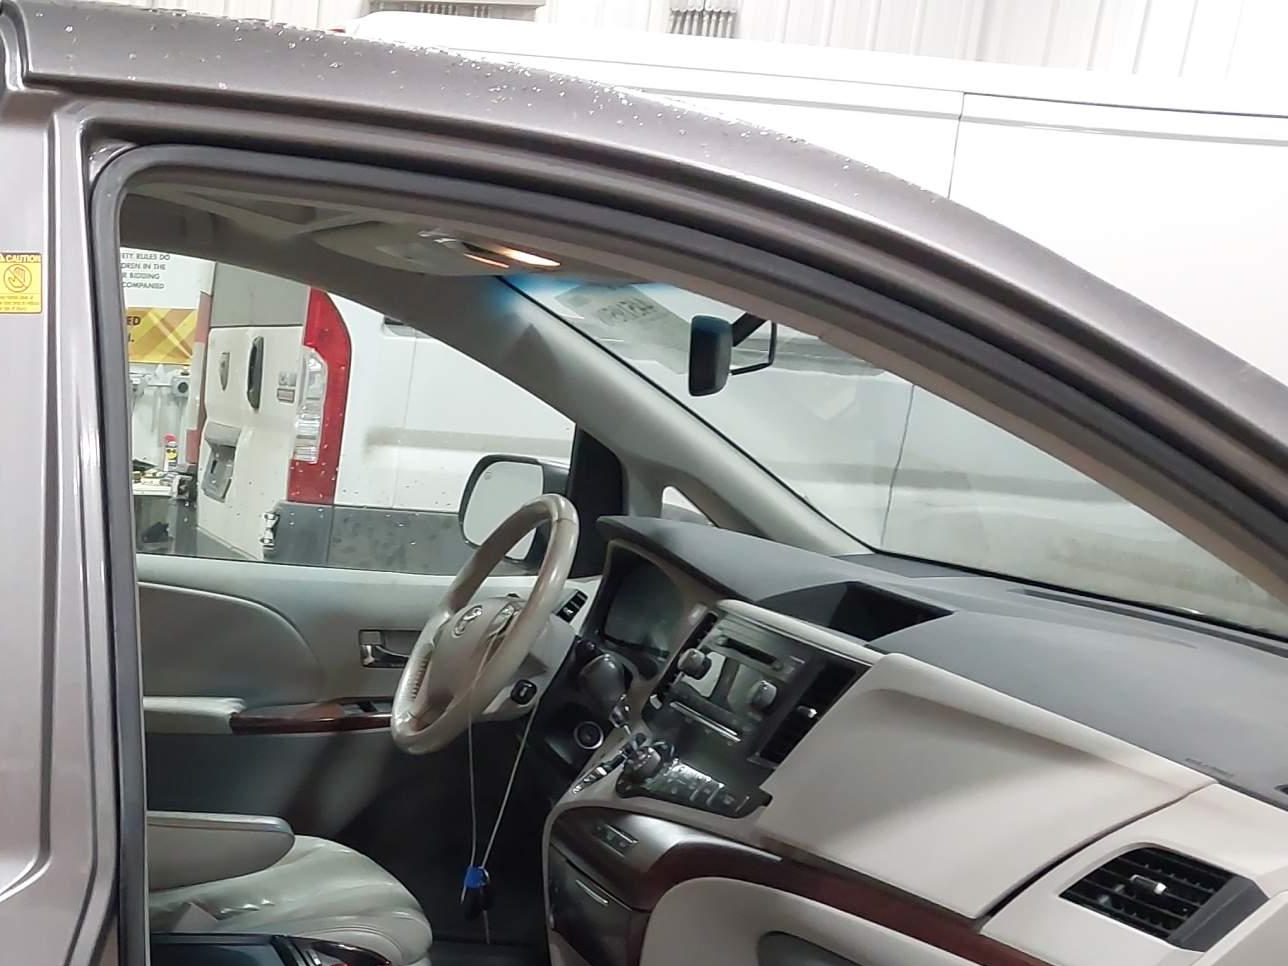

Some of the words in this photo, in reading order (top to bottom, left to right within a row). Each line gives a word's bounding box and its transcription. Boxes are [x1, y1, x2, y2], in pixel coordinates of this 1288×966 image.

[6, 254, 41, 263] CAUTION
[121, 281, 165, 289] COMPANIED
[126, 316, 141, 326] ED
